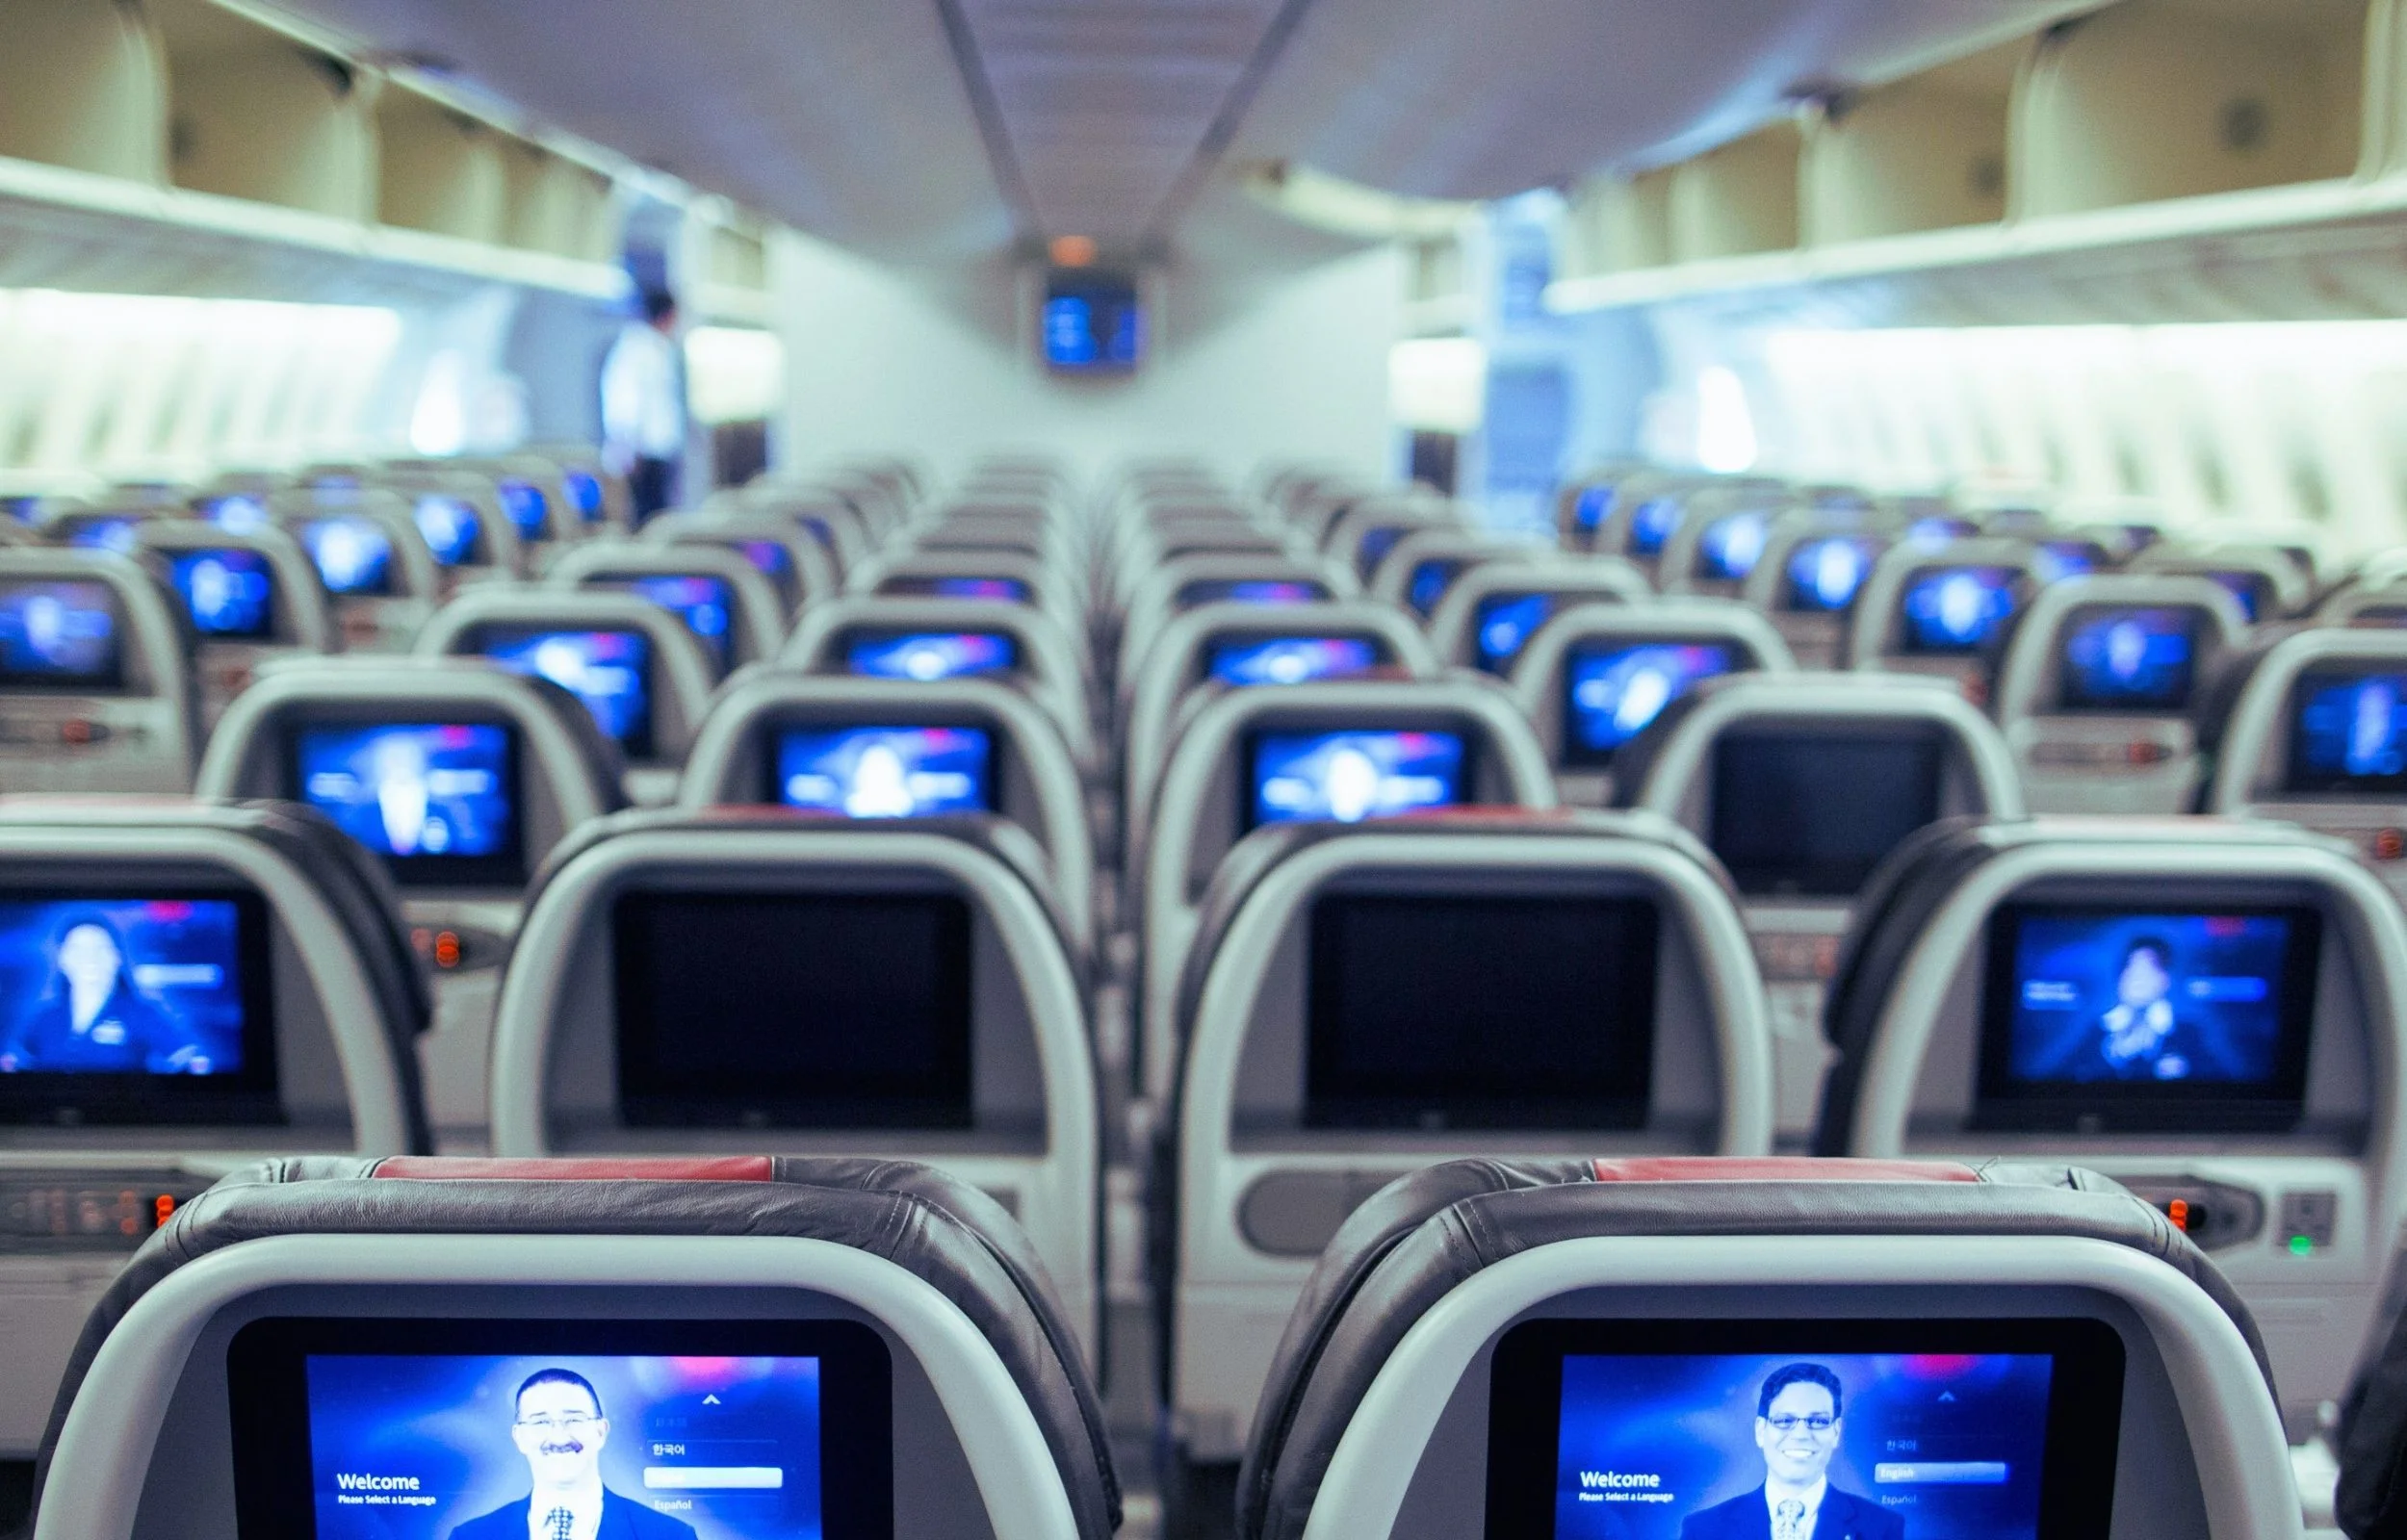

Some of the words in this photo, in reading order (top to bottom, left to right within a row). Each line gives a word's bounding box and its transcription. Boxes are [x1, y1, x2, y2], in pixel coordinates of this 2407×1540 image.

[652, 1443, 686, 1456] 한국어
[1580, 1471, 1661, 1488] Welcome
[1880, 1467, 1915, 1480] English
[337, 1473, 420, 1490] Welcome
[338, 1495, 364, 1504] Please
[365, 1495, 390, 1504] Select
[398, 1495, 436, 1506] Language
[1579, 1492, 1604, 1502] Please
[1605, 1492, 1629, 1502] Select
[1637, 1492, 1674, 1503] Language
[1881, 1494, 1917, 1506] Español
[654, 1500, 692, 1512] Español
